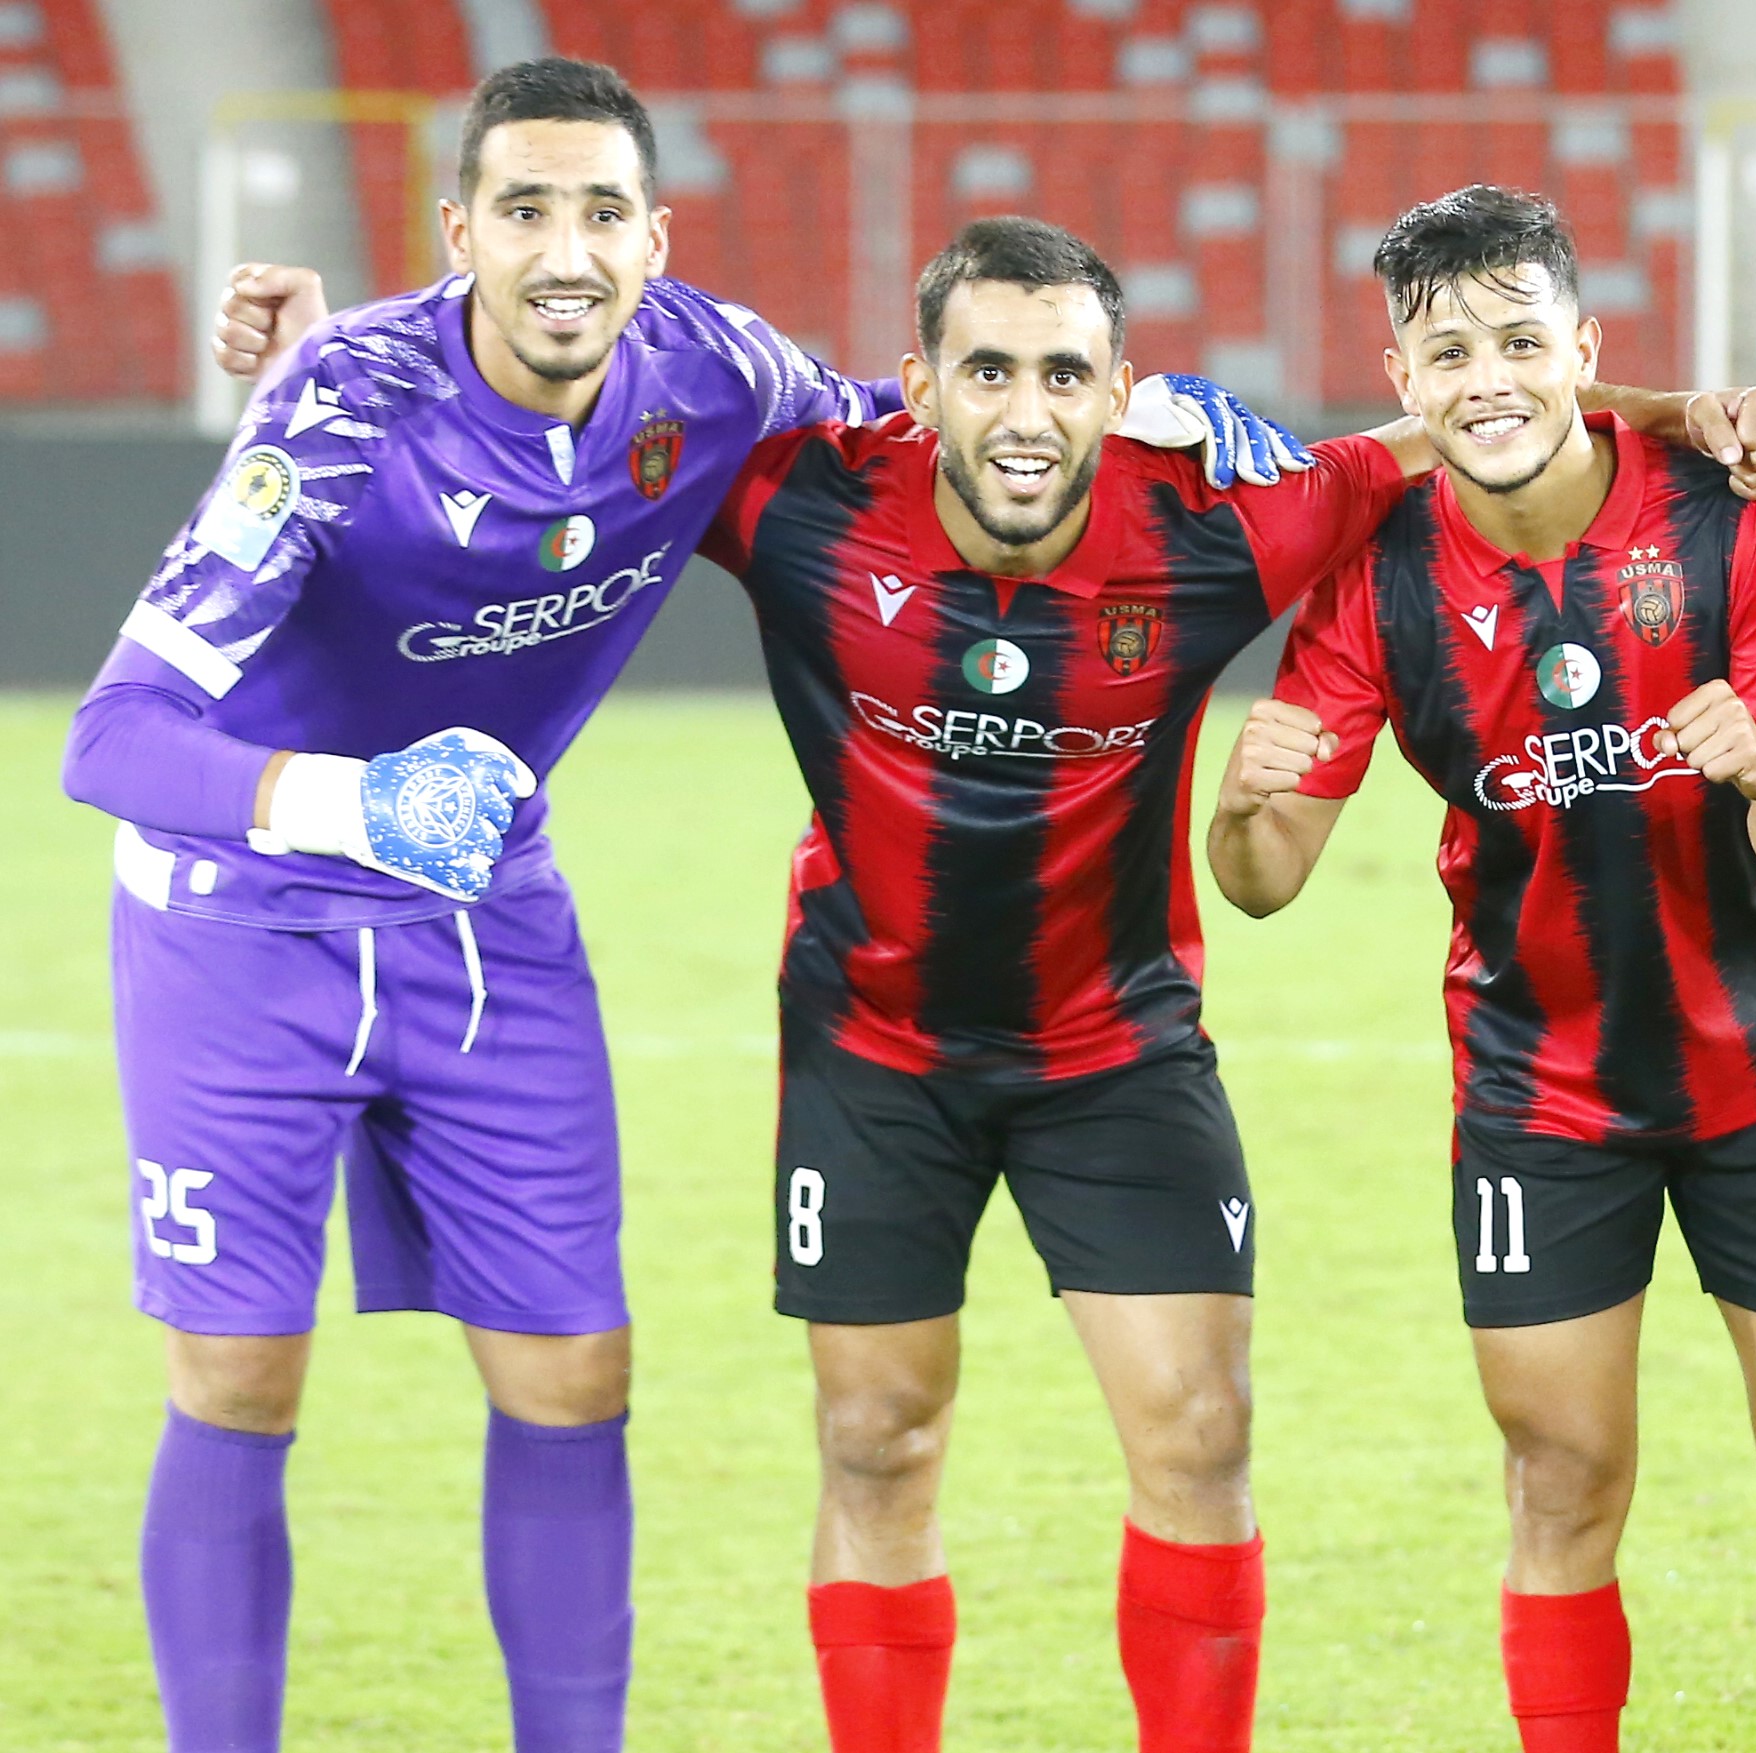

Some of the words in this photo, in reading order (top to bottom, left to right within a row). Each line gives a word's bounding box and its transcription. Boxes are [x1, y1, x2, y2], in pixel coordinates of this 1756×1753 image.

[474, 541, 673, 641] SERPO
[1104, 604, 1158, 617] USMA
[1621, 563, 1675, 579] USMA
[1525, 717, 1686, 787] SERPO
[136, 1157, 218, 1265] 25
[788, 1166, 826, 1266] 8
[1475, 1176, 1531, 1273] 11
